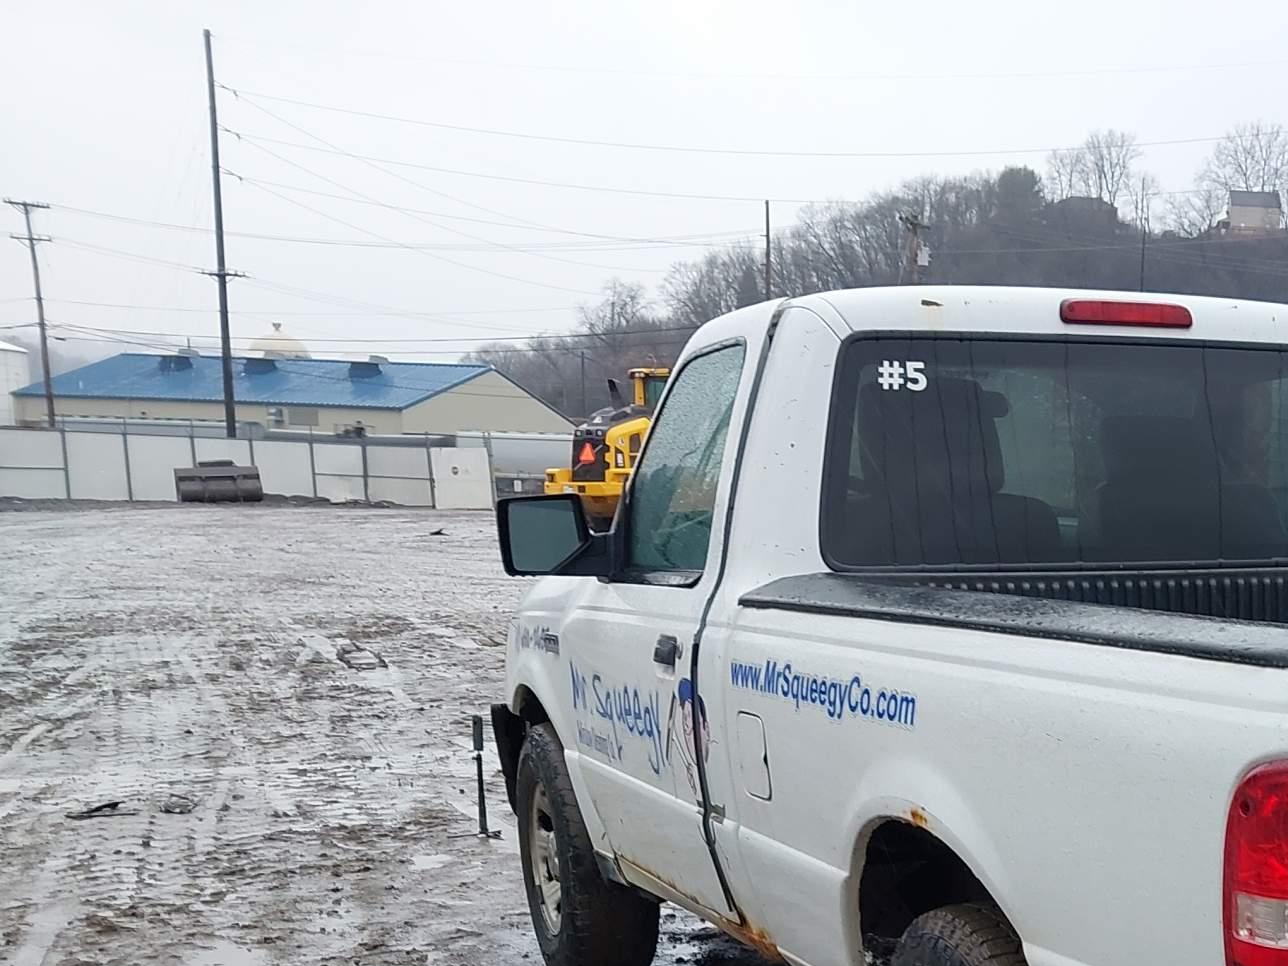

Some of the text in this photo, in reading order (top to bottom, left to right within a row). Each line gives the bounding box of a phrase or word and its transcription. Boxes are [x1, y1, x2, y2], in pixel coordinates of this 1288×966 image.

[877, 360, 928, 391] #5
[592, 673, 666, 775] Squeegy
[731, 660, 916, 726] www.MrSqueegyCo.com
